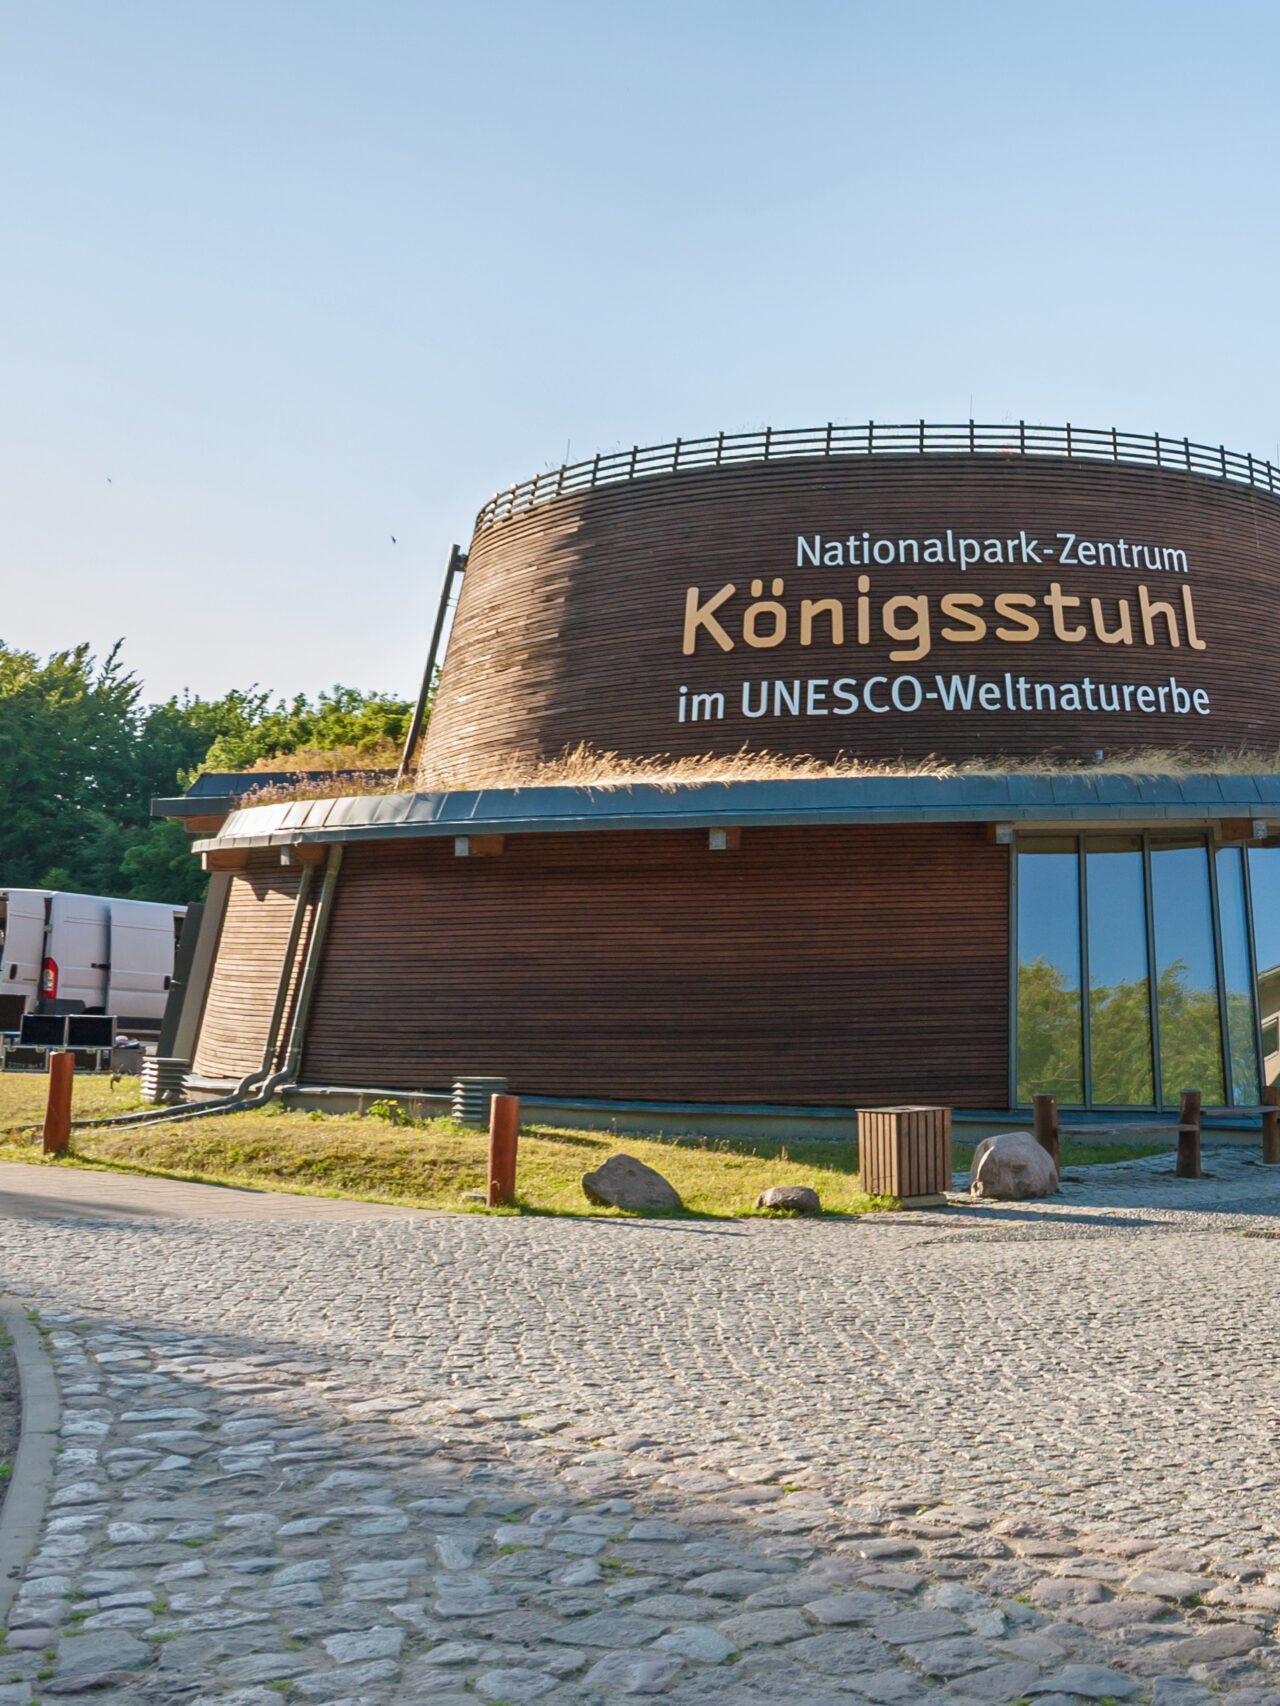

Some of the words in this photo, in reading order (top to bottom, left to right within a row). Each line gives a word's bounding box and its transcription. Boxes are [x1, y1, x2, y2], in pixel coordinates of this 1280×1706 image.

[796, 529, 1188, 572] Nationalpark-Zentrum
[682, 574, 1206, 662] Königsstuhl
[678, 685, 725, 723] im
[741, 672, 1211, 718] UNESCO-Weltnaturerbe
